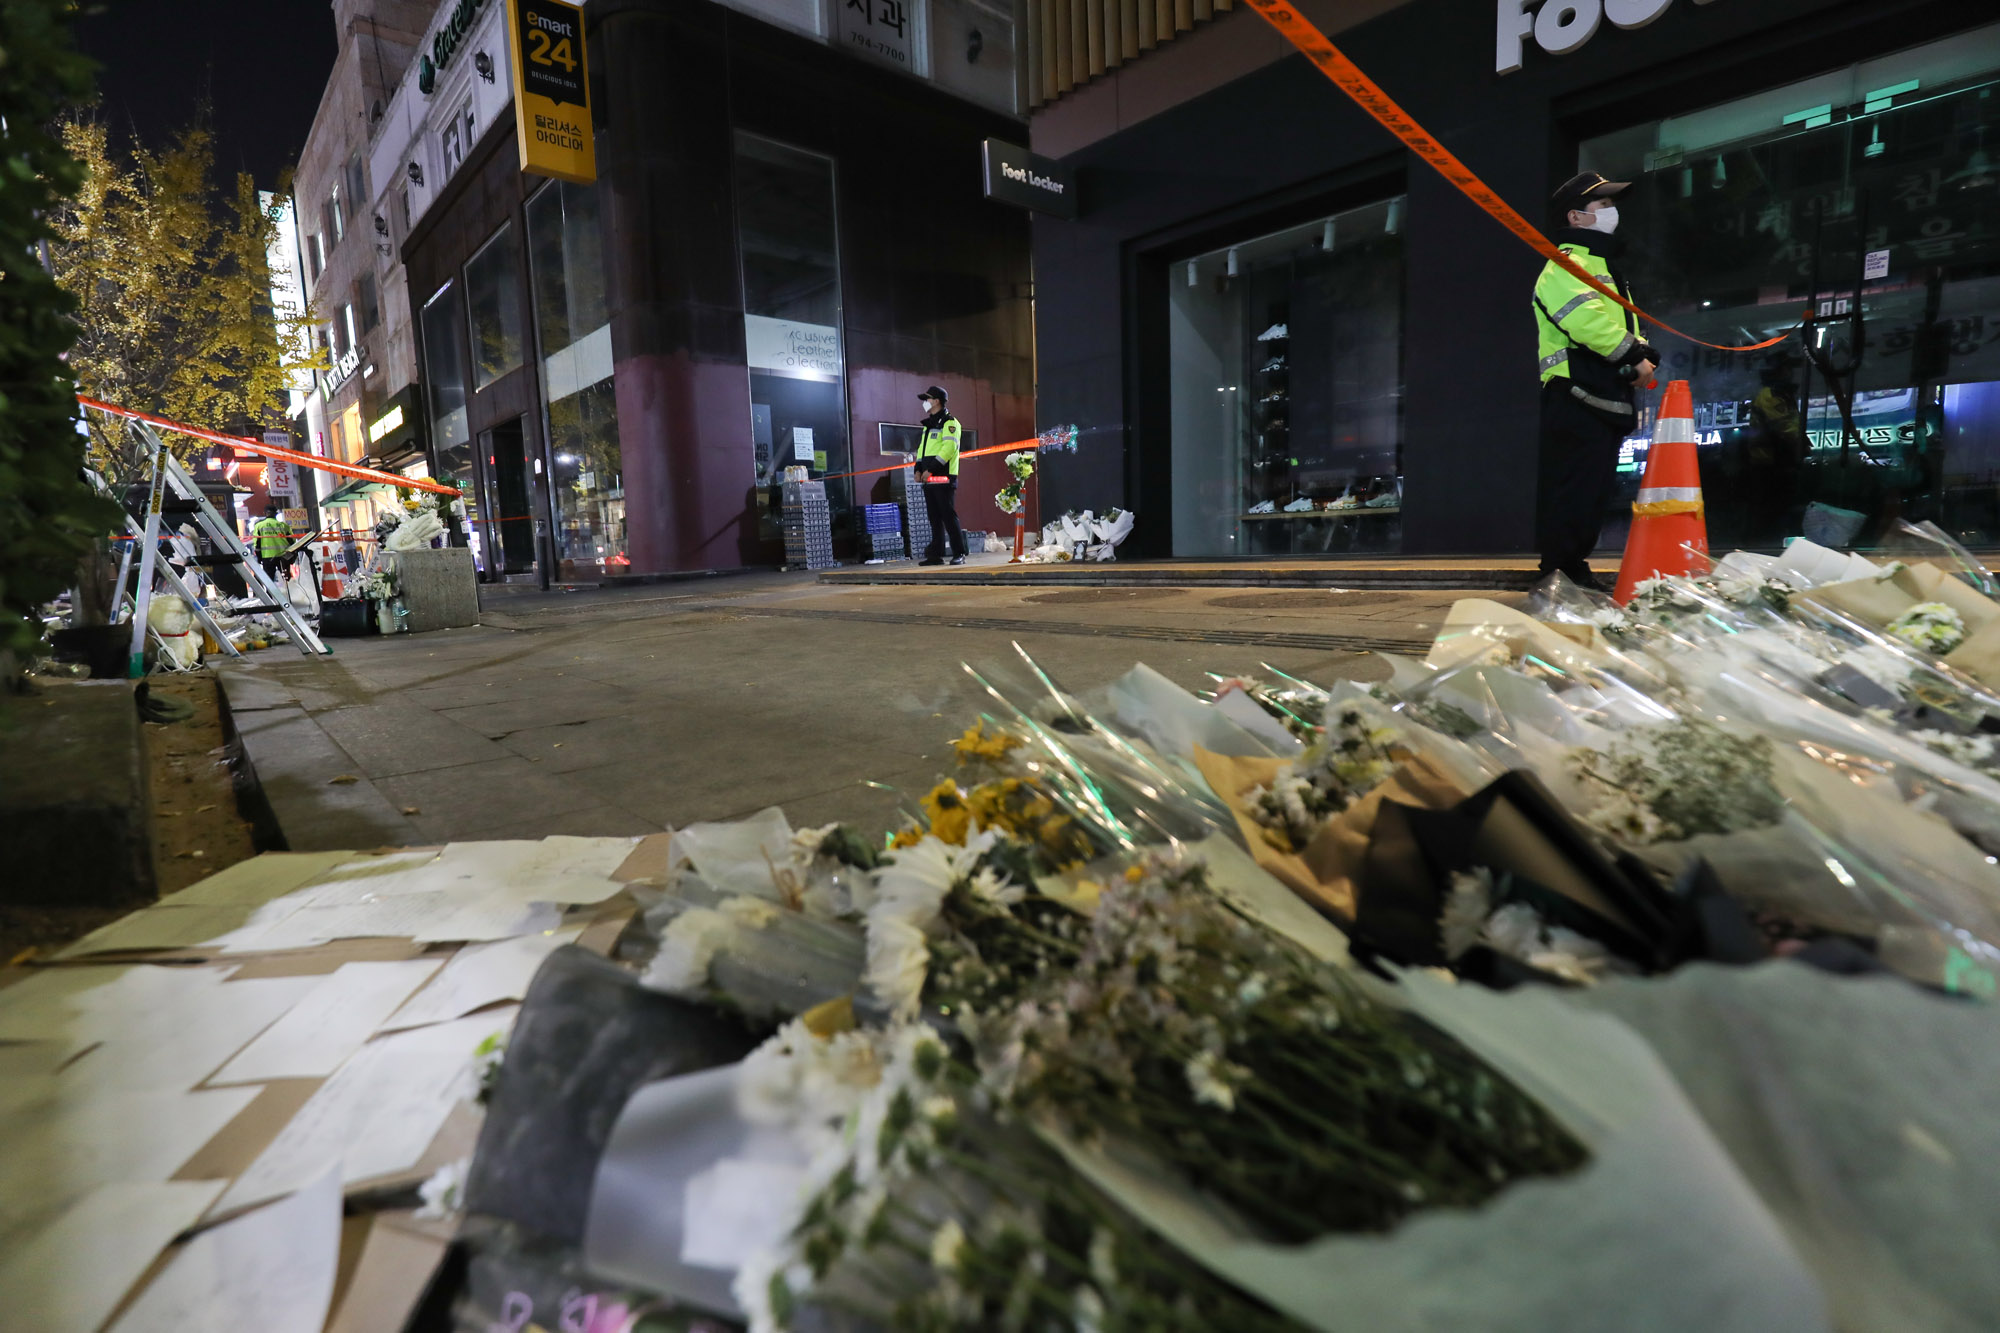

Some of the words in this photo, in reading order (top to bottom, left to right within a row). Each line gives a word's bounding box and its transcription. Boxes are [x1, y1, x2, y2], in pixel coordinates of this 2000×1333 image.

[526, 11, 573, 38] emart
[528, 28, 577, 73] 24
[850, 31, 905, 62] 794-7700
[531, 71, 563, 86] DELICIOUS
[563, 79, 577, 89] IDEA
[534, 113, 582, 137] 딜리셔스
[536, 129, 583, 152] 아이디어
[1001, 162, 1027, 184] Foot
[1028, 170, 1064, 195] Locker
[285, 510, 306, 519] MOON
